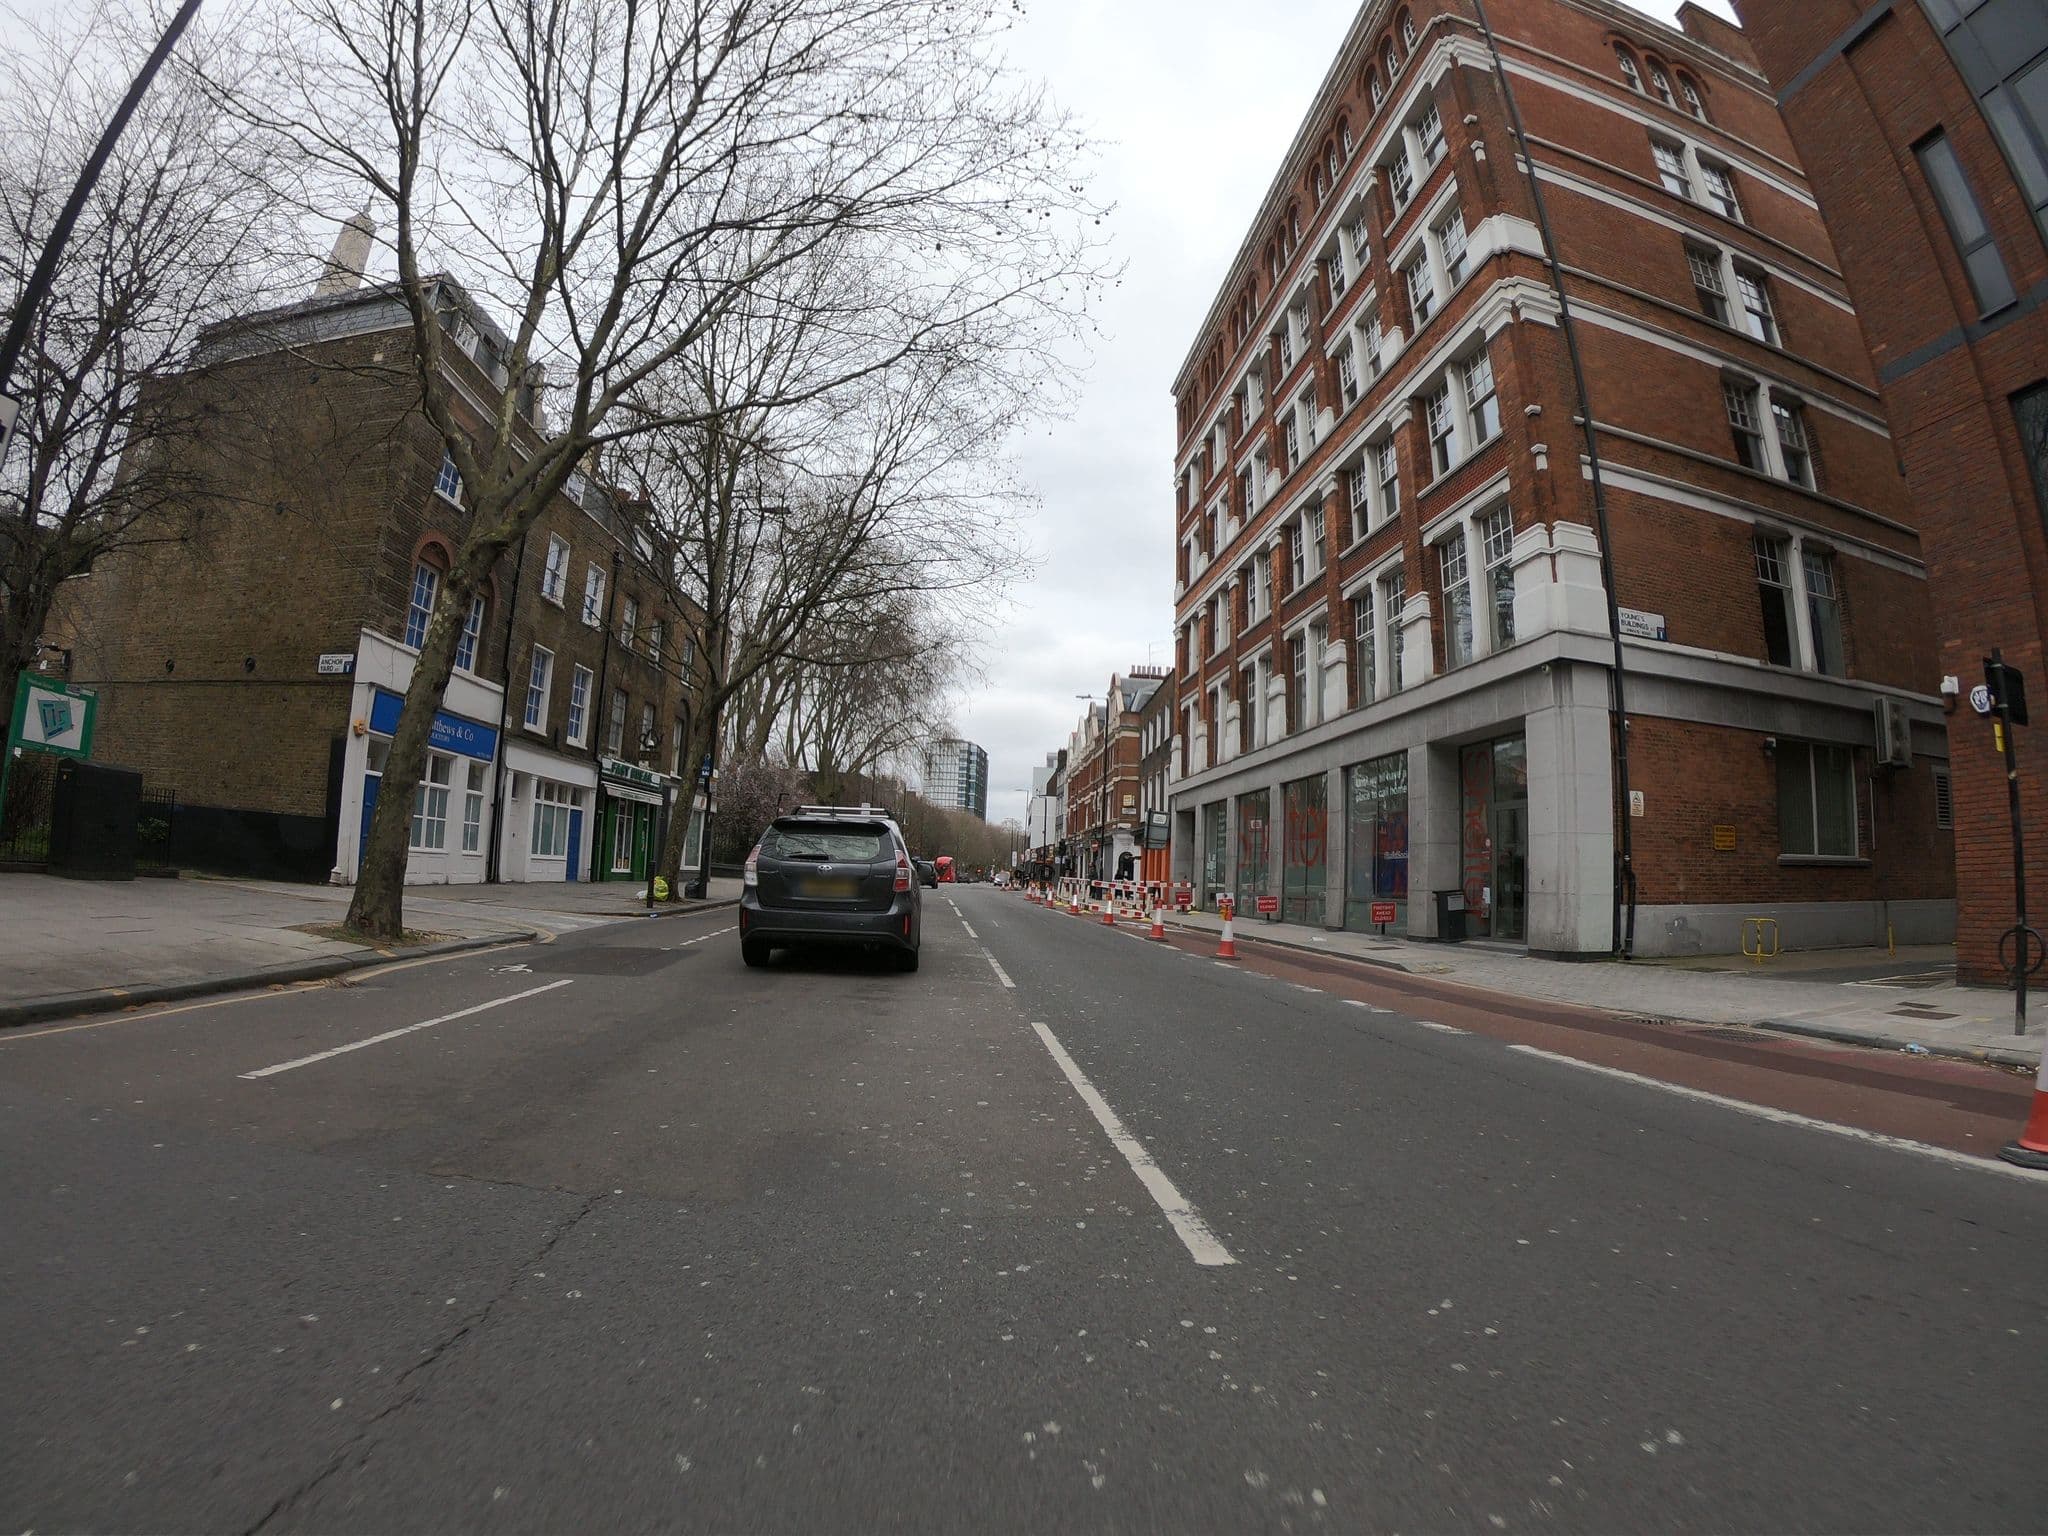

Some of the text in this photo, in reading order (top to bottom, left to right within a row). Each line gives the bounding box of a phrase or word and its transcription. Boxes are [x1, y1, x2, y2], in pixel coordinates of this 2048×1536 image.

[1621, 612, 1646, 622] YOUNG'S
[1621, 619, 1649, 630] BUILDINGS
[464, 728, 474, 742] Co
